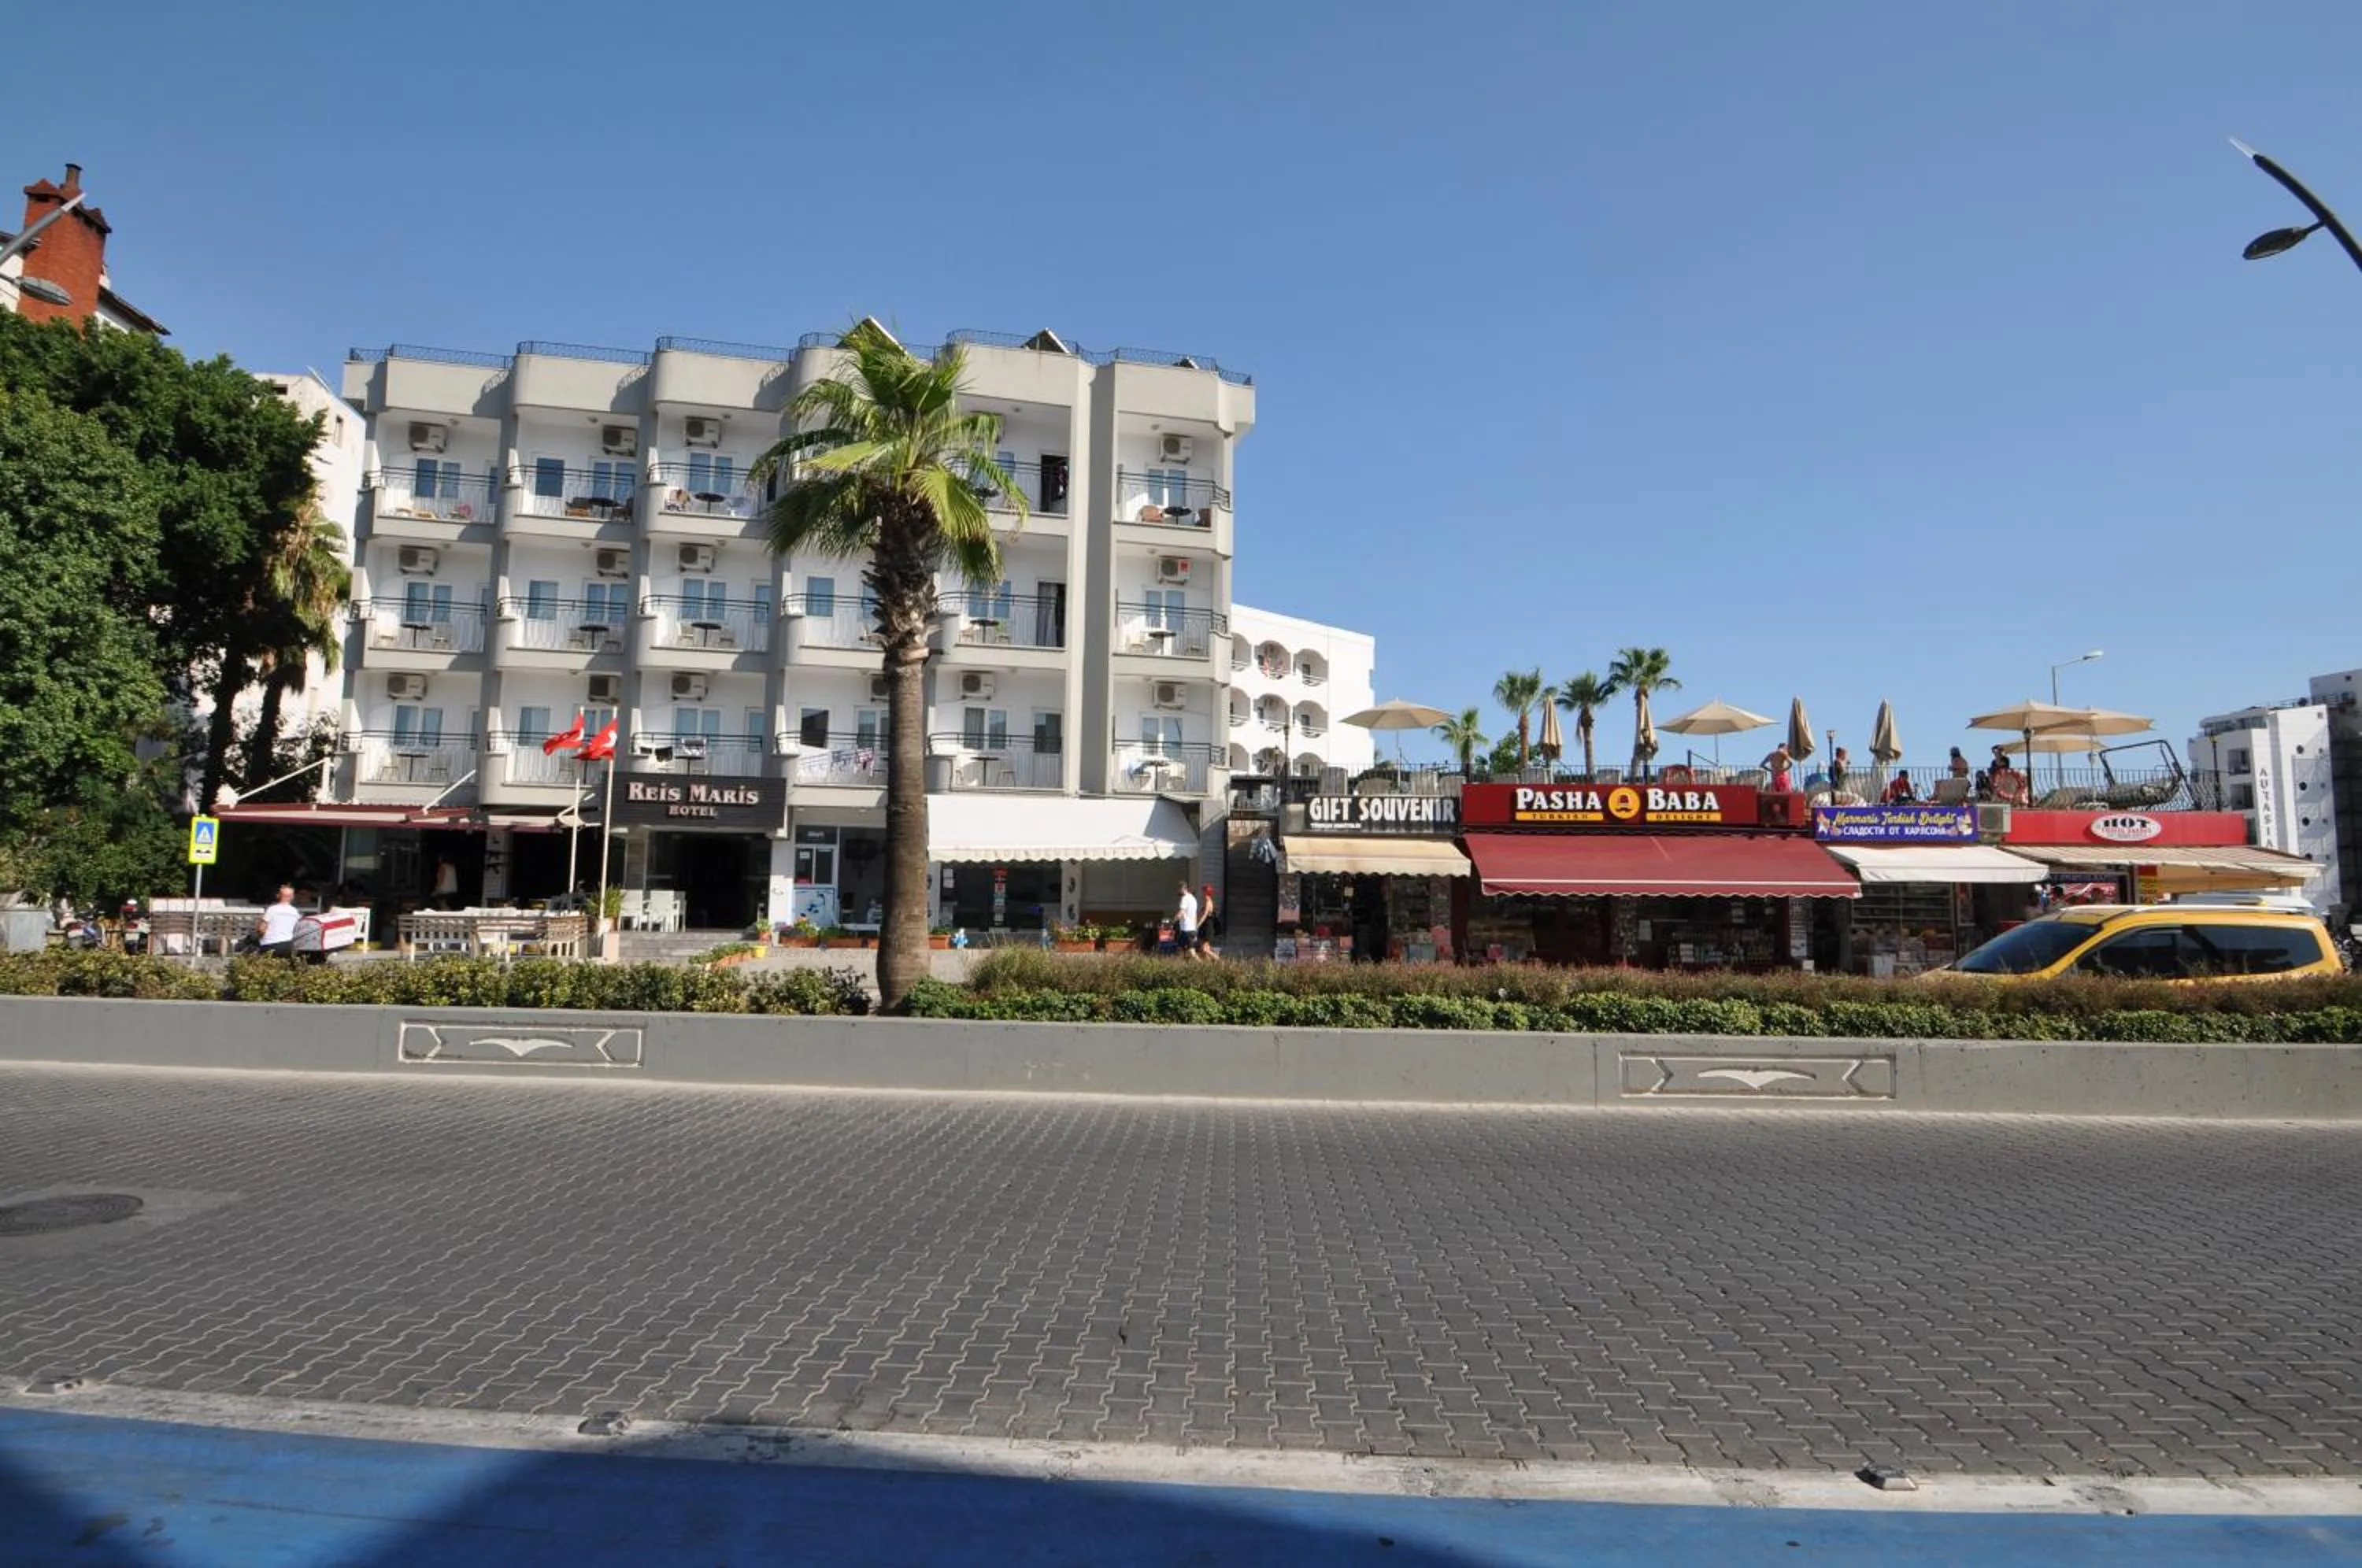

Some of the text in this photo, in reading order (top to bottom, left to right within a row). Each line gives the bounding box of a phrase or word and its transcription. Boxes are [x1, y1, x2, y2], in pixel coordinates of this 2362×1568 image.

[1516, 788, 1720, 811] PASHA BABA
[669, 804, 718, 816] HOTEL
[1309, 797, 1455, 822] GIFT SOUVENIR
[1881, 812, 1916, 826] Turkish
[1917, 812, 1957, 827] Delight
[2103, 818, 2150, 828] HOT
[1843, 826, 1885, 836] СЛАДОСТИ
[1889, 827, 1900, 835] ОТ
